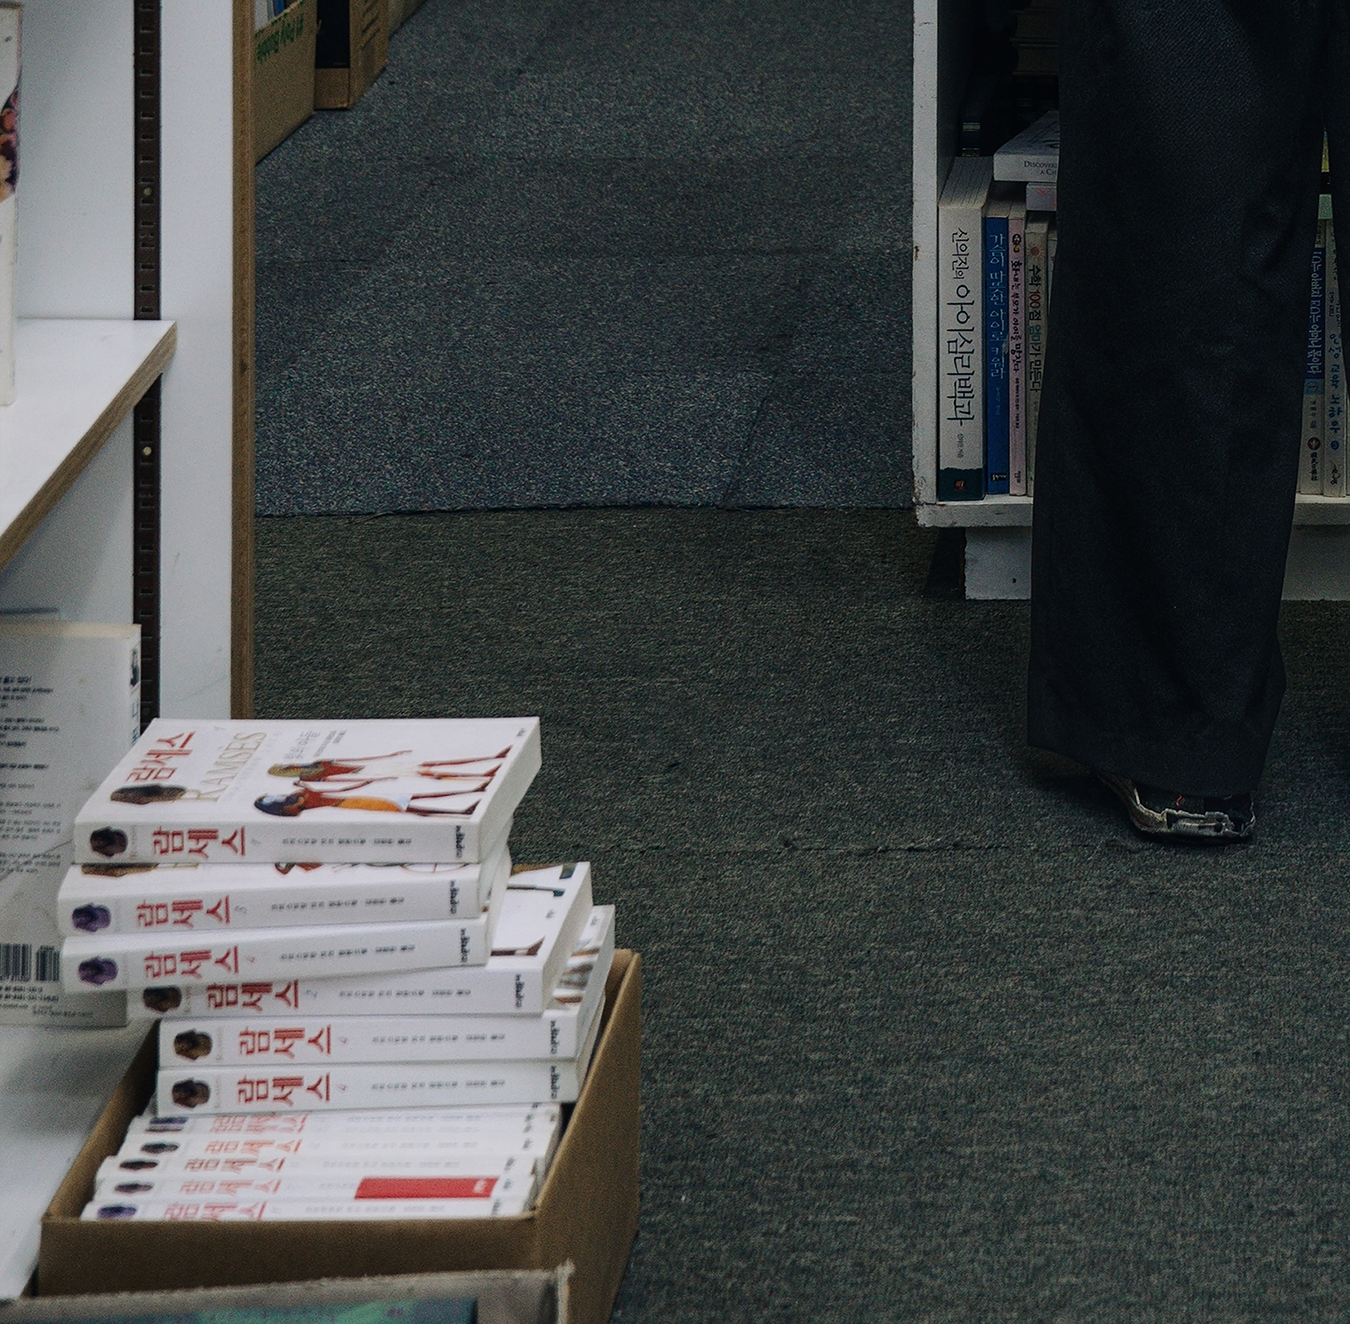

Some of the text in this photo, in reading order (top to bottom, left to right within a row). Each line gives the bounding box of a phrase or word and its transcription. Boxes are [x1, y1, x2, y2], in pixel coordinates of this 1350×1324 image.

[946, 227, 975, 427] 신의진의 아이심리백과
[126, 729, 196, 784] 람세스
[151, 825, 246, 857] 람세스
[136, 894, 232, 929] 람세스
[143, 945, 240, 980] 람세스
[206, 979, 299, 1012] 람세스
[237, 1024, 332, 1059] 람세스
[237, 1072, 331, 1105] 람세스
